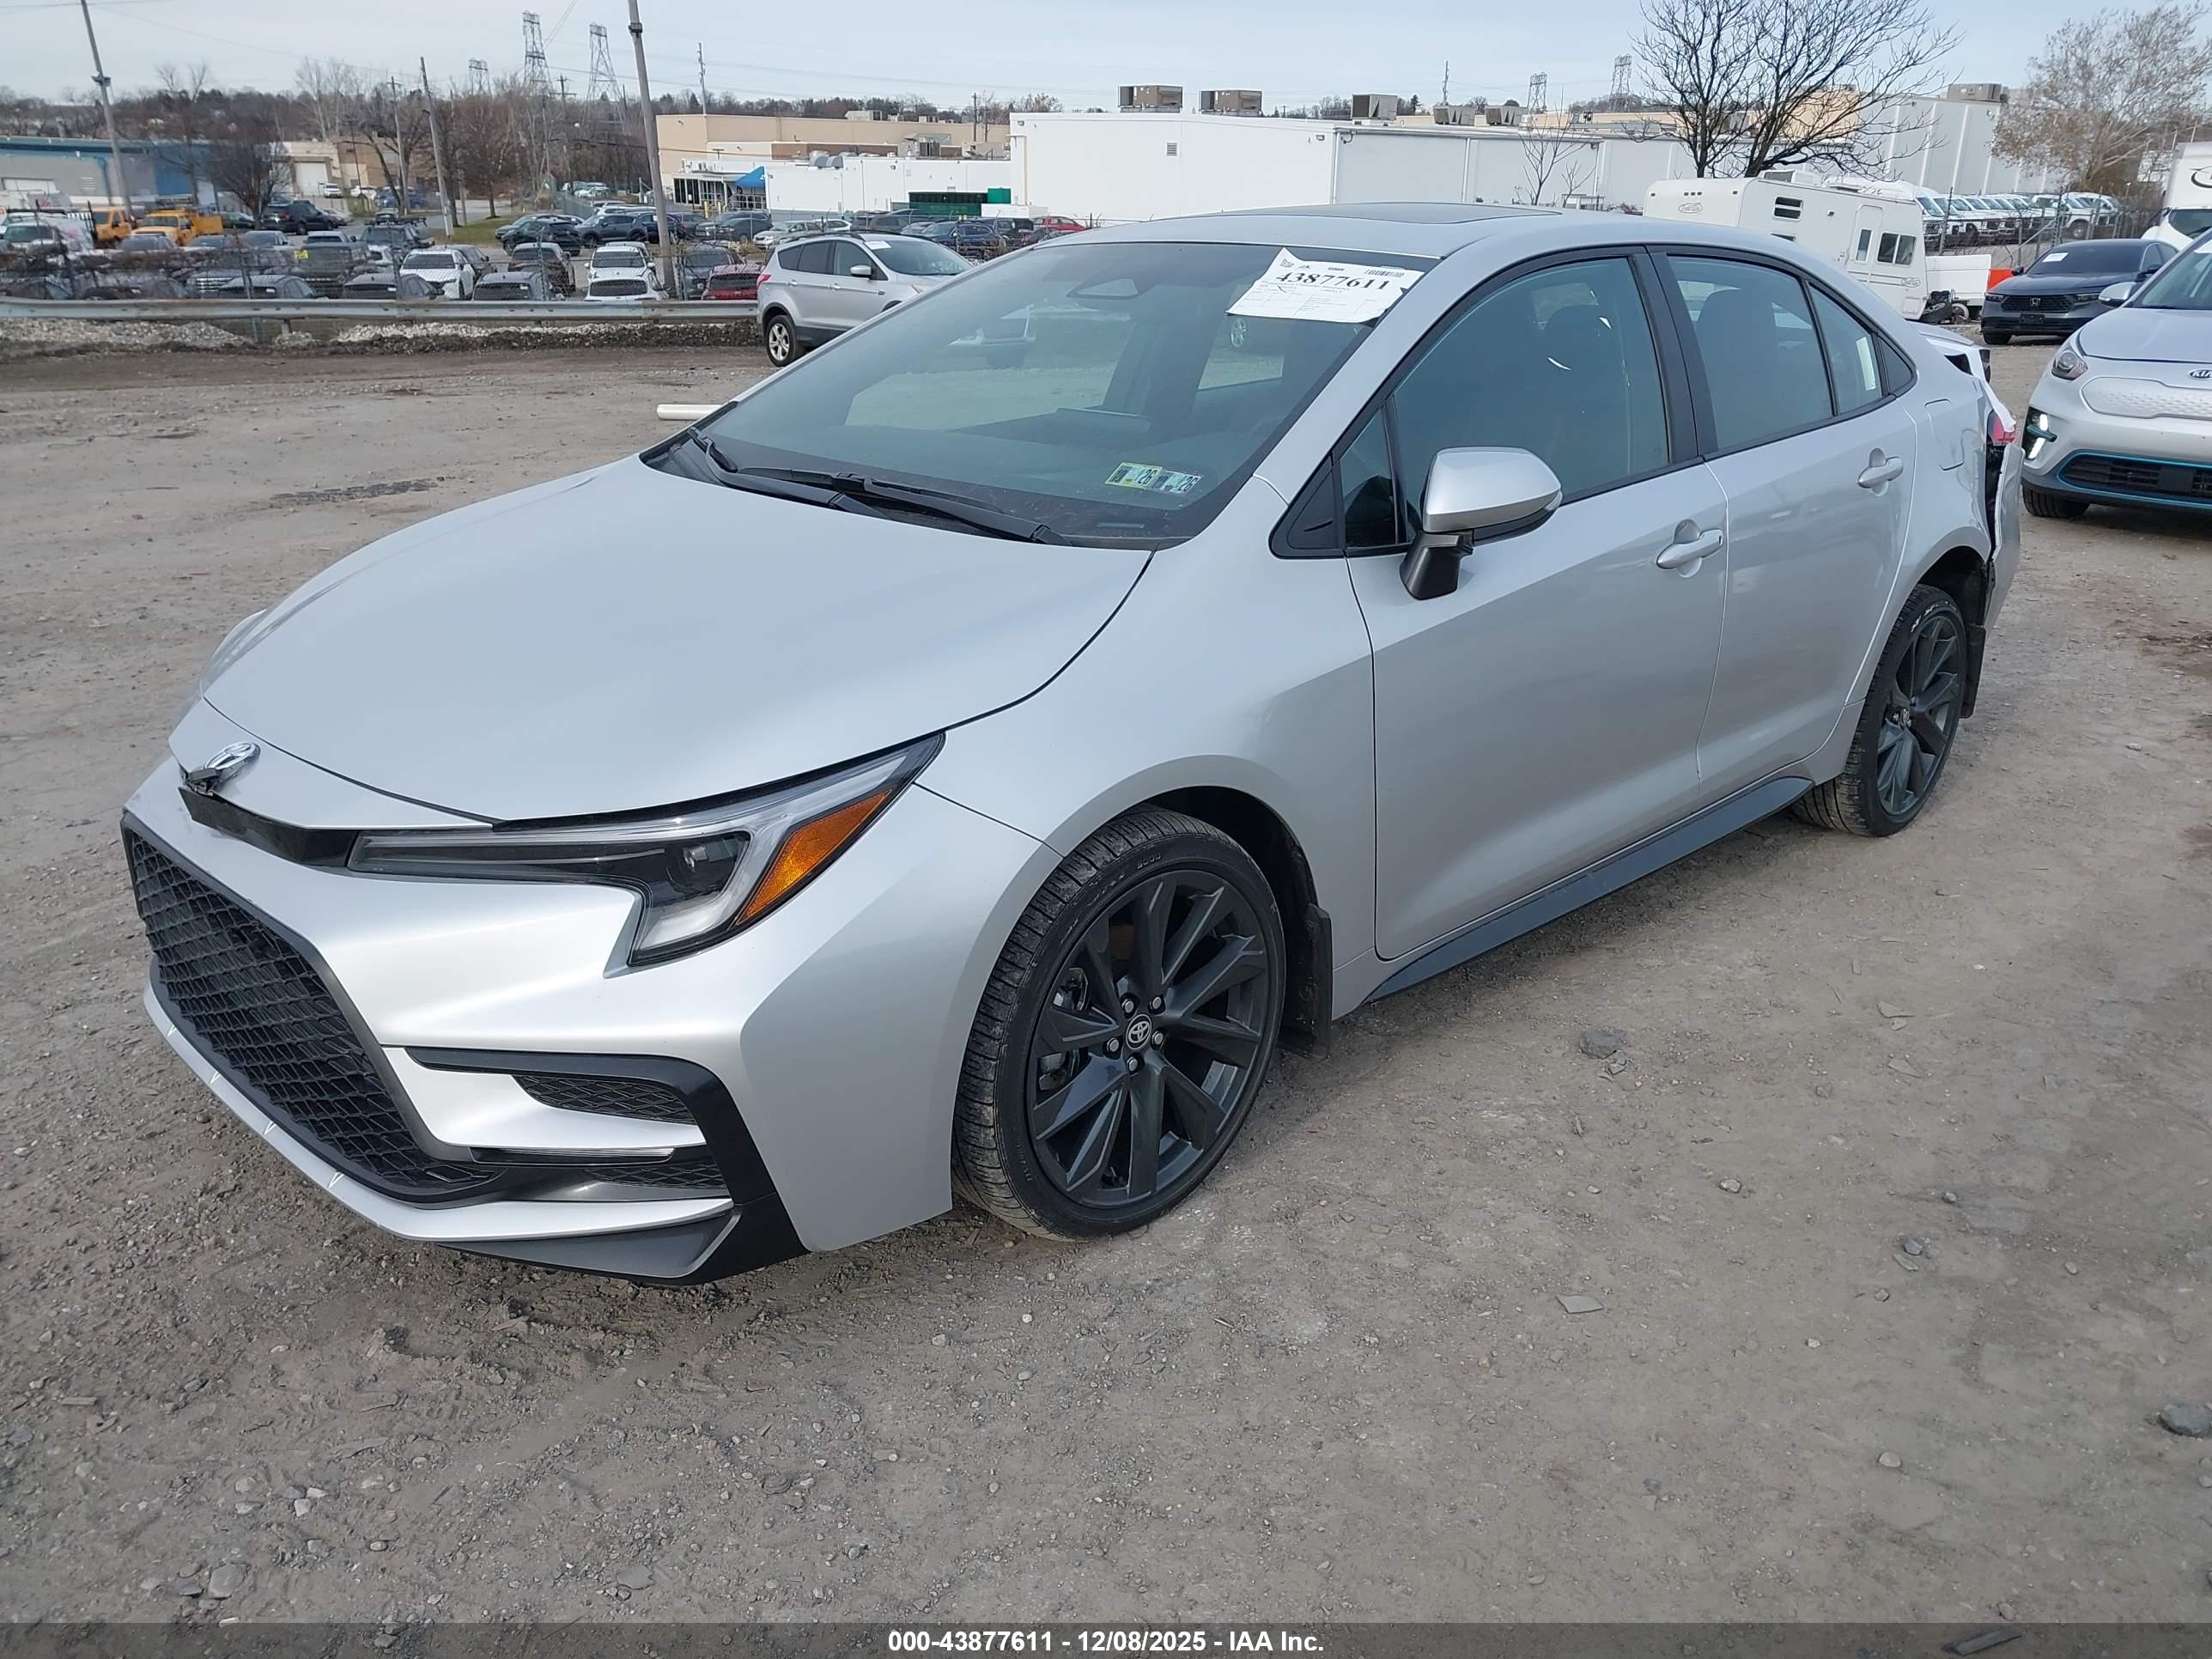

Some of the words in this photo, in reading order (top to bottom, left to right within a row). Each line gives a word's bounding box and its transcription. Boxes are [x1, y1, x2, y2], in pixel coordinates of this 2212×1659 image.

[1276, 271, 1390, 290] 43877611
[1138, 468, 1158, 485] 26
[1177, 475, 1199, 493] 26
